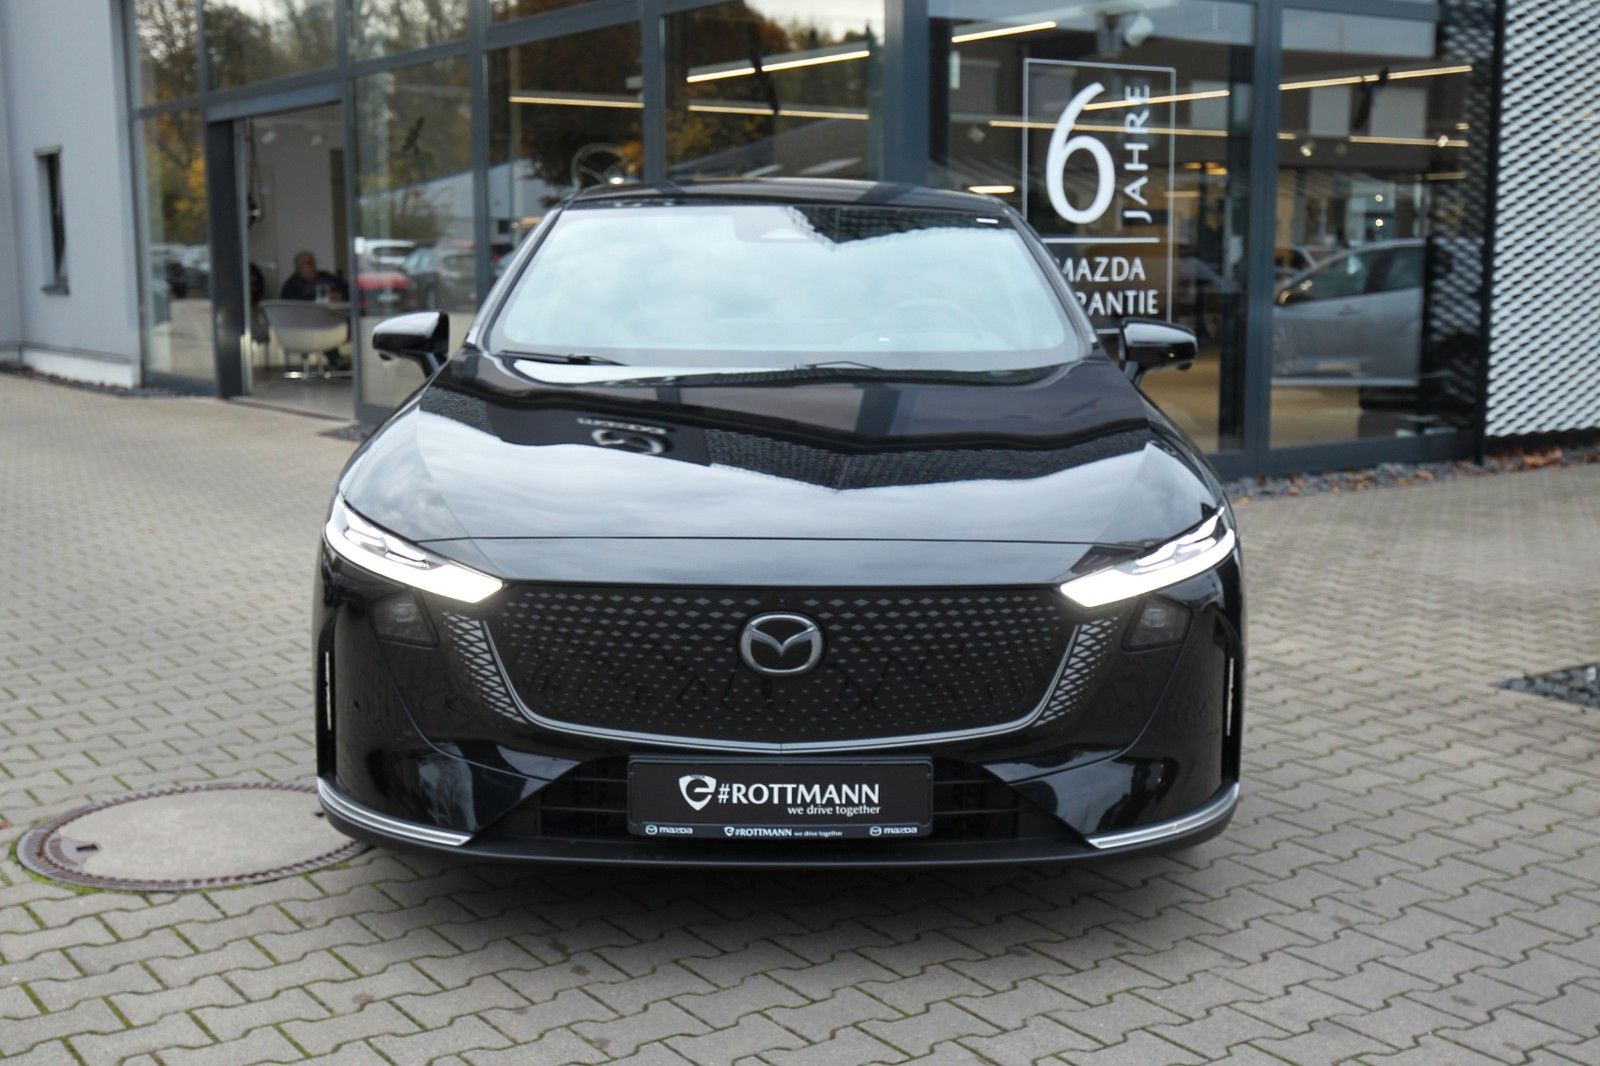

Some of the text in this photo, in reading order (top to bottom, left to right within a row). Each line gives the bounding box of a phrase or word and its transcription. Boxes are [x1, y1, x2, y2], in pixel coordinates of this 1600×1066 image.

[1045, 81, 1116, 224] 6
[1123, 84, 1152, 223] JAHRE
[1075, 289, 1159, 316] ANTIE
[718, 783, 879, 804] #ROTTMANN
[787, 805, 881, 817] we drive together
